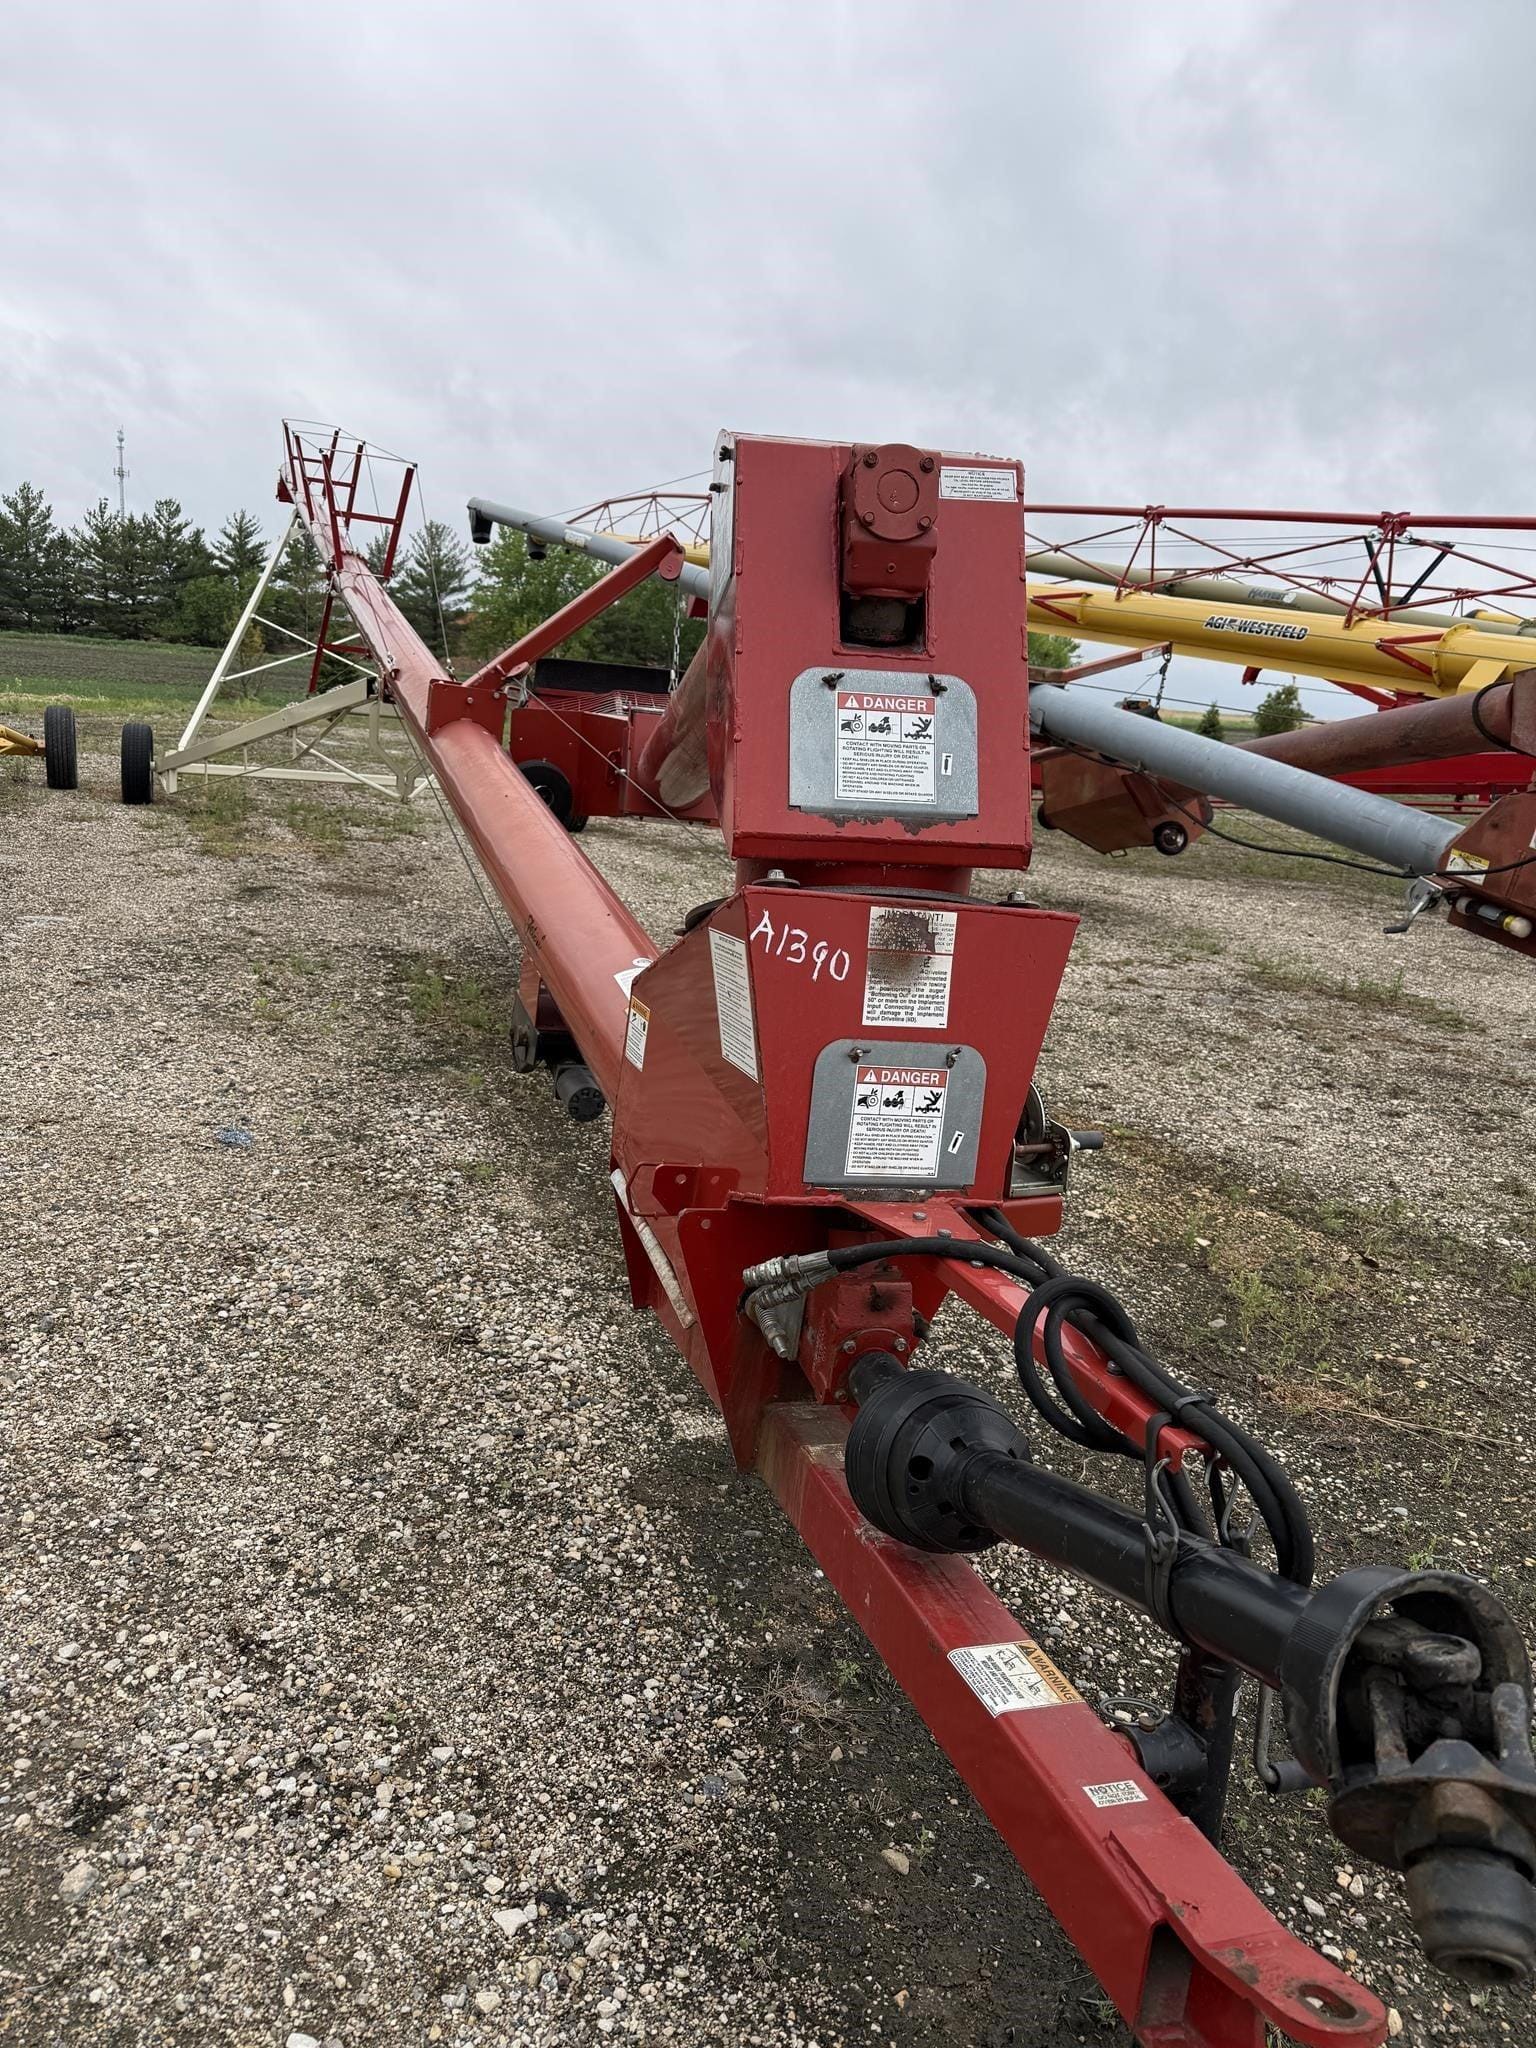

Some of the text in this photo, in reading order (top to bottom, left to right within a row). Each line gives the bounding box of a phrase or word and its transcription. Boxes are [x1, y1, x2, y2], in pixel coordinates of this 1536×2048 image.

[1205, 616, 1308, 640] AGI WESTFIELD
[864, 697, 926, 711] DANGER
[750, 908, 850, 982] A1390
[881, 1070, 940, 1084] DANGER
[1032, 1655, 1076, 1700] WARNING
[1089, 1782, 1136, 1796] NOTICE
